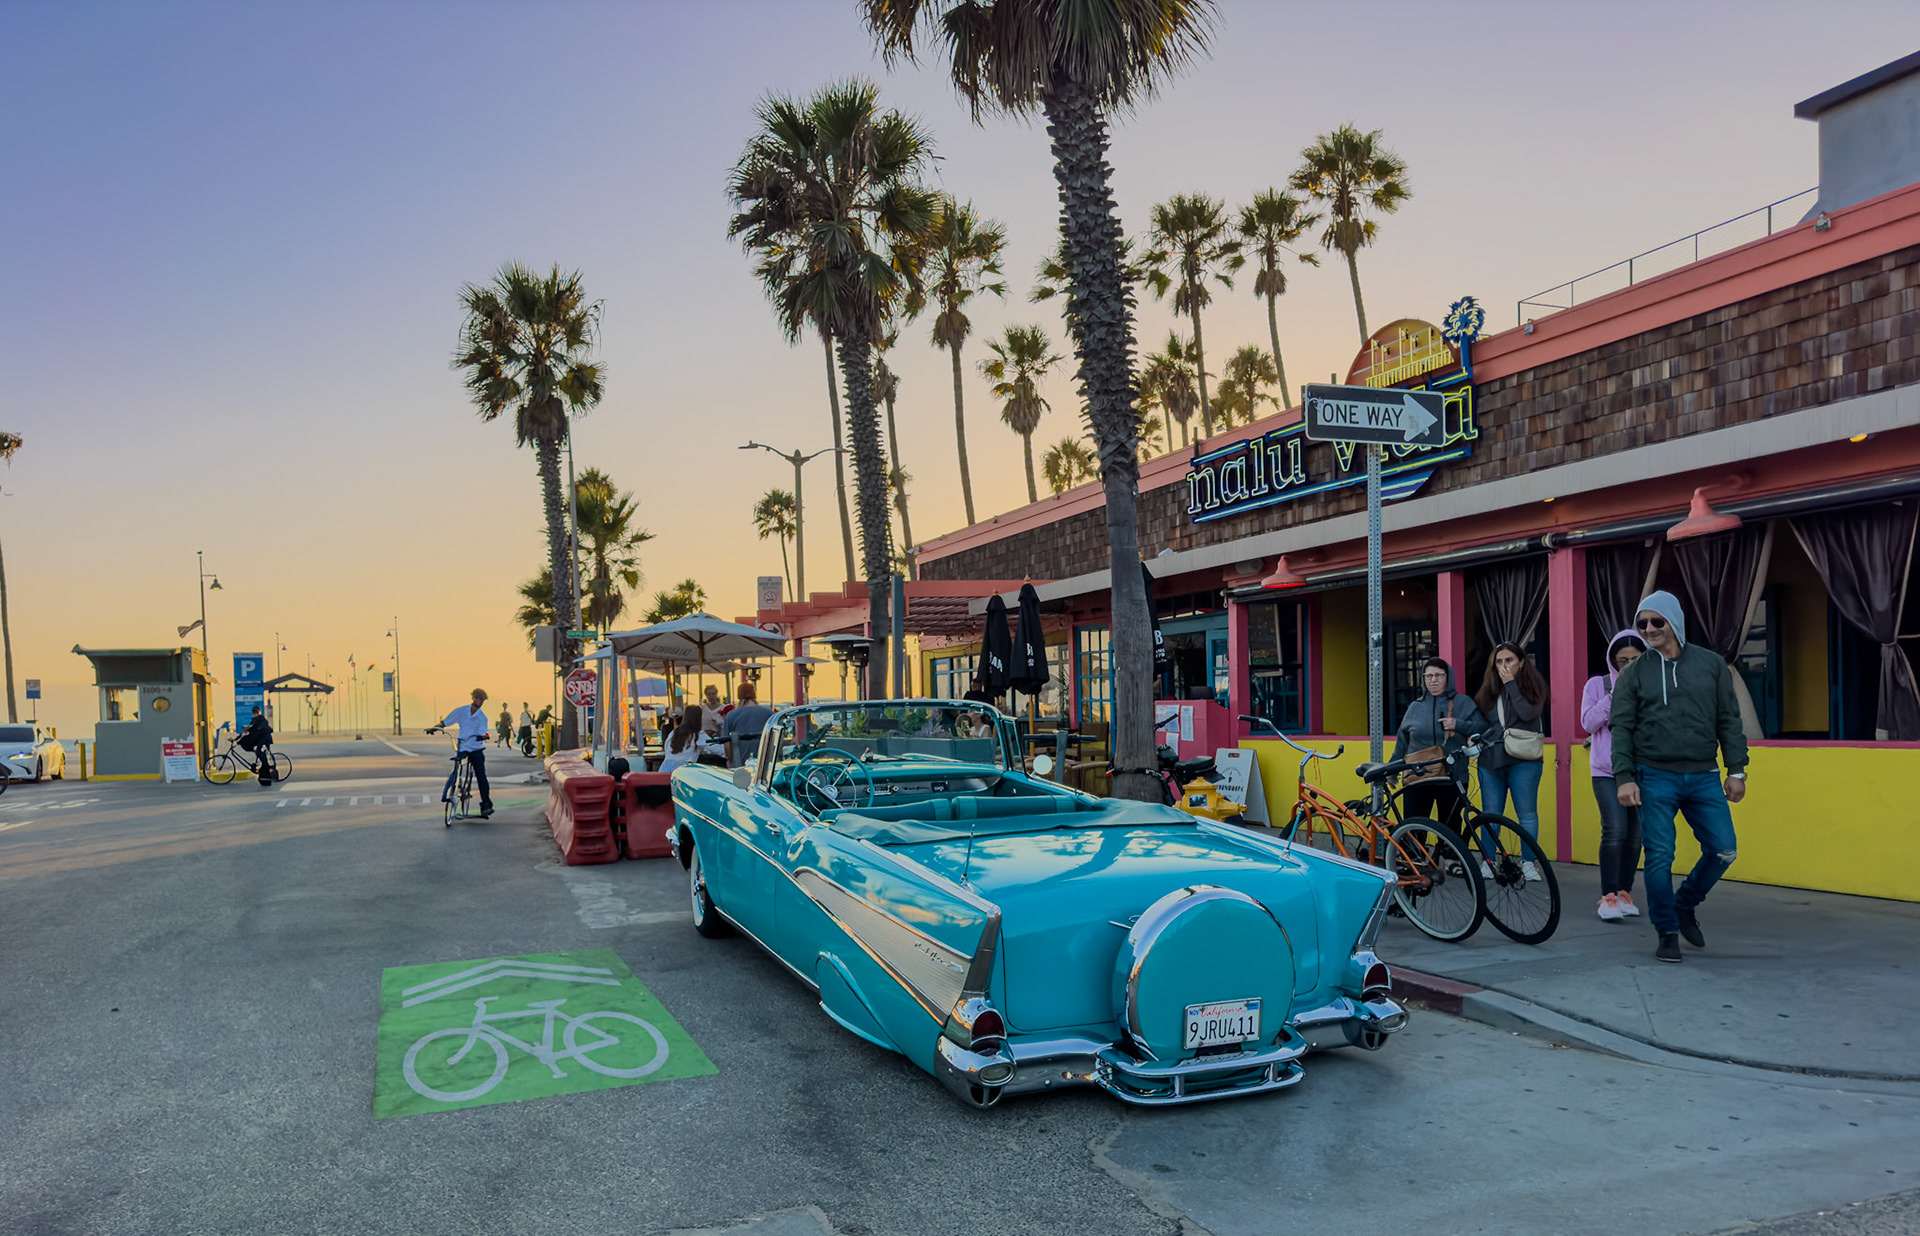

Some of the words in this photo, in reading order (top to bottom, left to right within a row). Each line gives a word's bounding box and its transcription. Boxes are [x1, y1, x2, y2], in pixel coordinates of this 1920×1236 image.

[1322, 403, 1360, 425] ONE
[1366, 405, 1404, 427] WAY
[1186, 438, 1306, 514] nalu
[241, 660, 256, 678] P
[1201, 1006, 1244, 1018] California
[1190, 1015, 1255, 1042] 9JRU411
